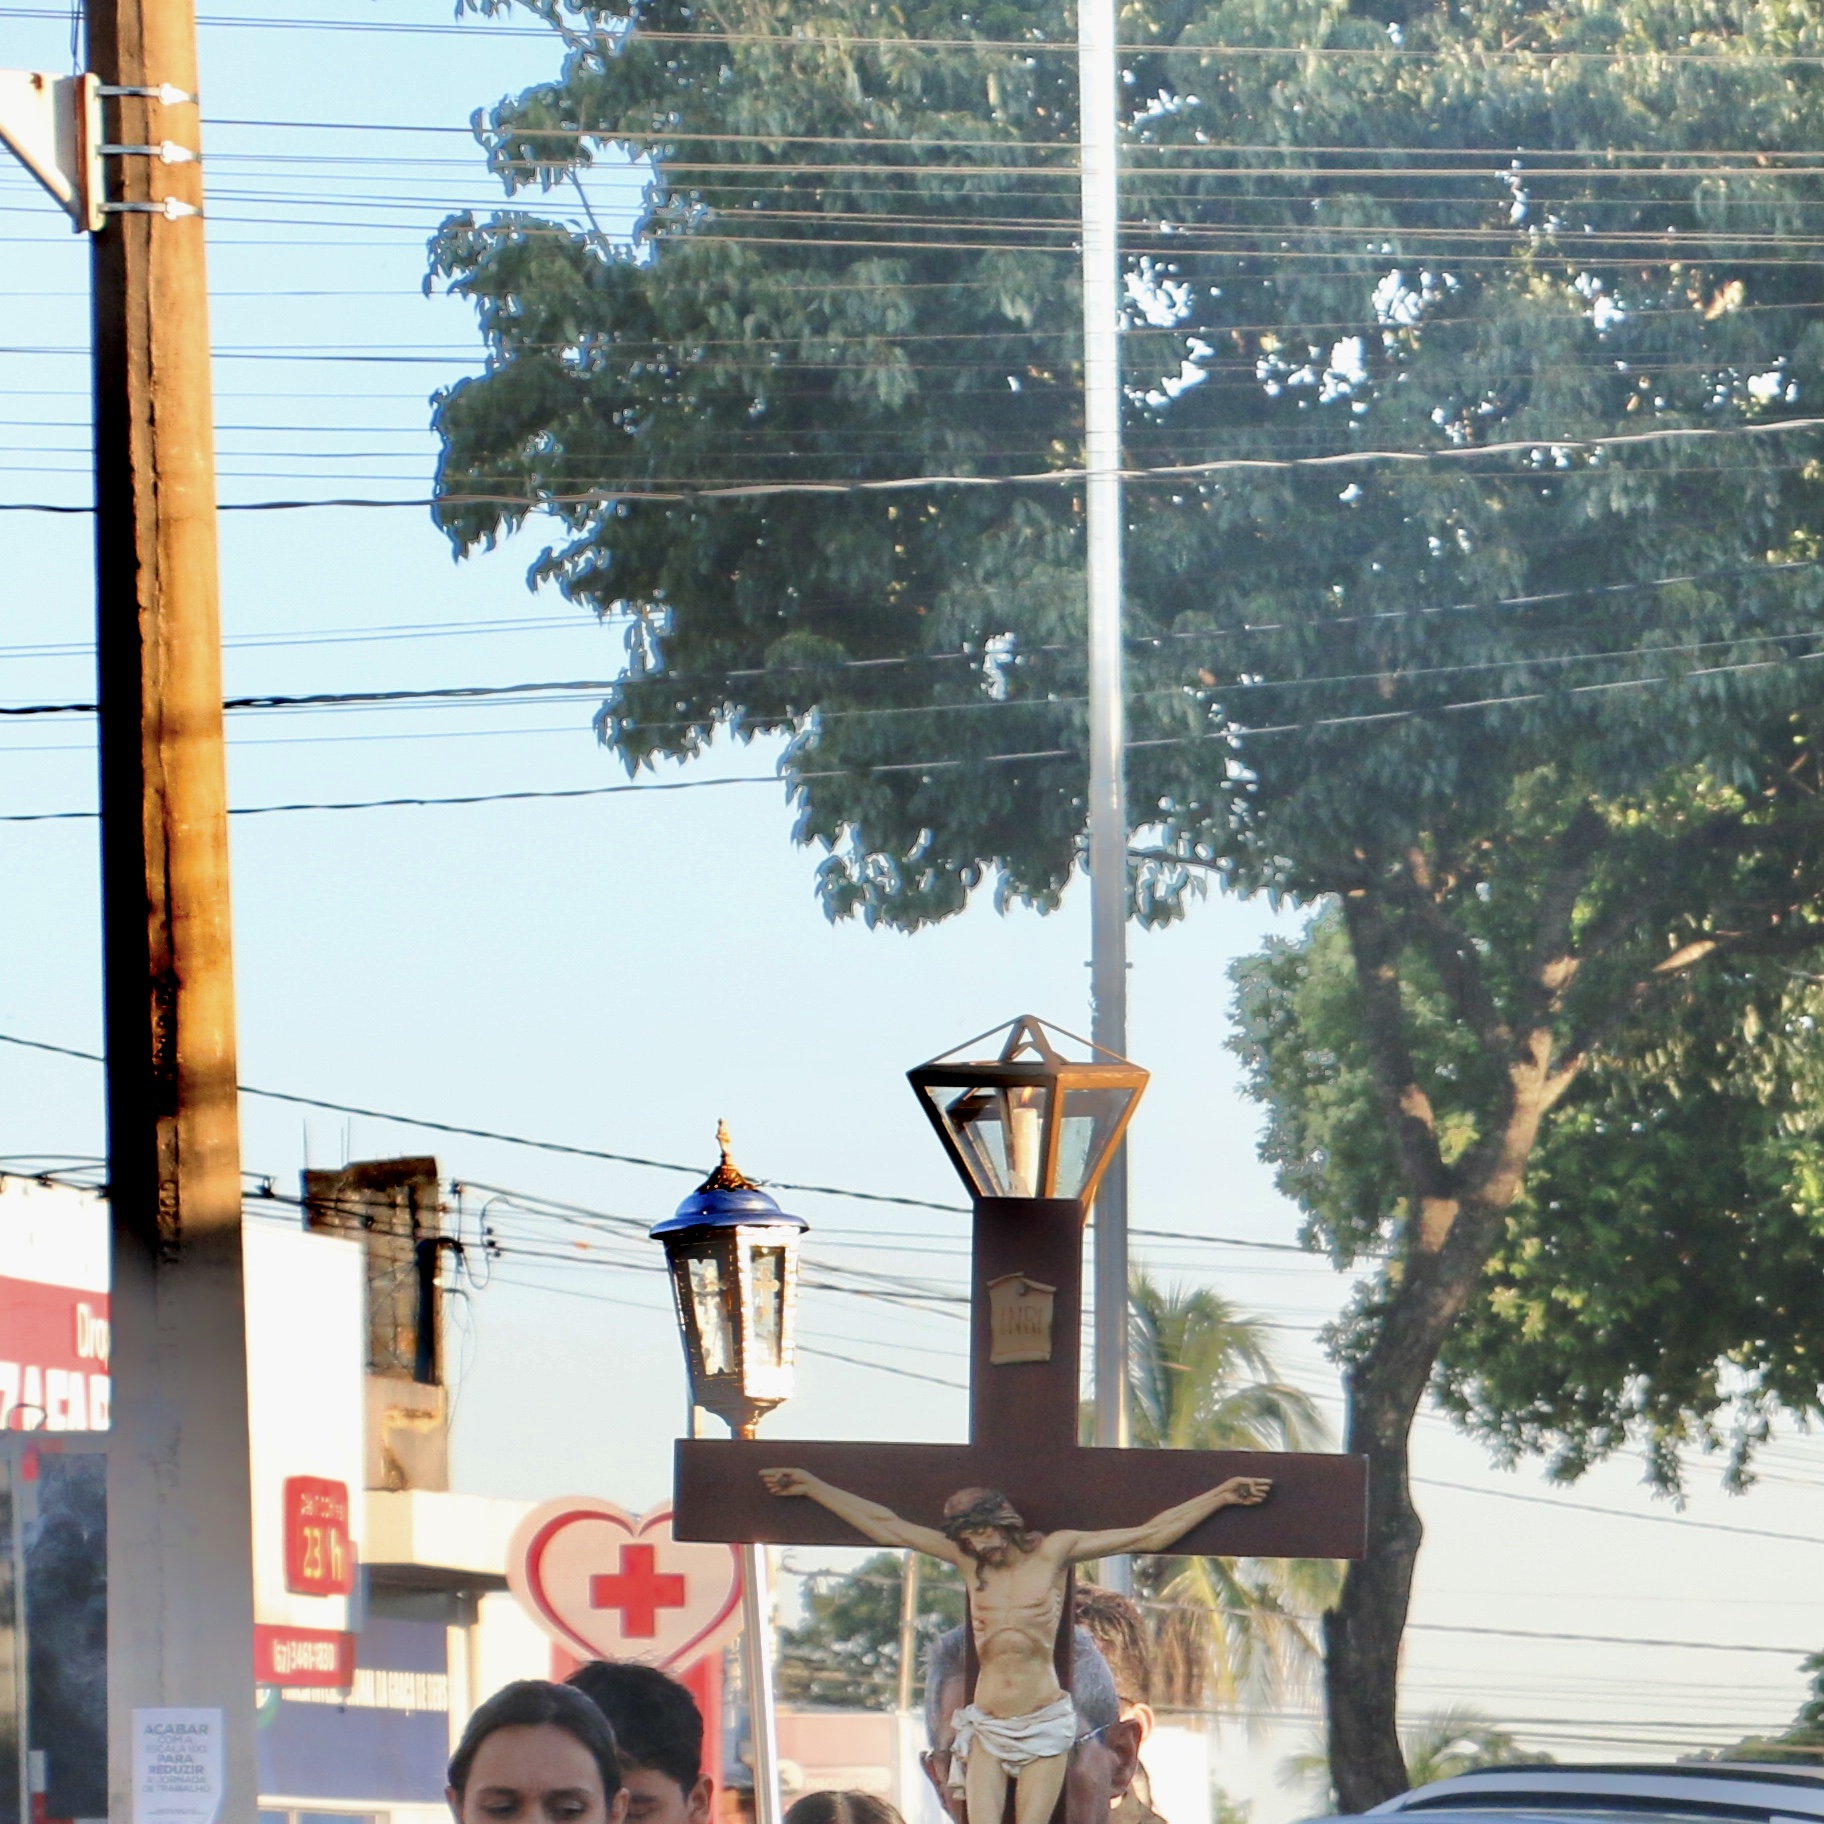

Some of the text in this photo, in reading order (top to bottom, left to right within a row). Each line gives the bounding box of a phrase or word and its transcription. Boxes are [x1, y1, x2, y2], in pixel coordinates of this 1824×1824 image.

[144, 1723, 209, 1735] ACABAR
[157, 1754, 194, 1763] PARA
[148, 1765, 204, 1774] REDUZIR
[156, 1776, 206, 1784] JORNADA
[155, 1784, 211, 1793] TRABALHO
